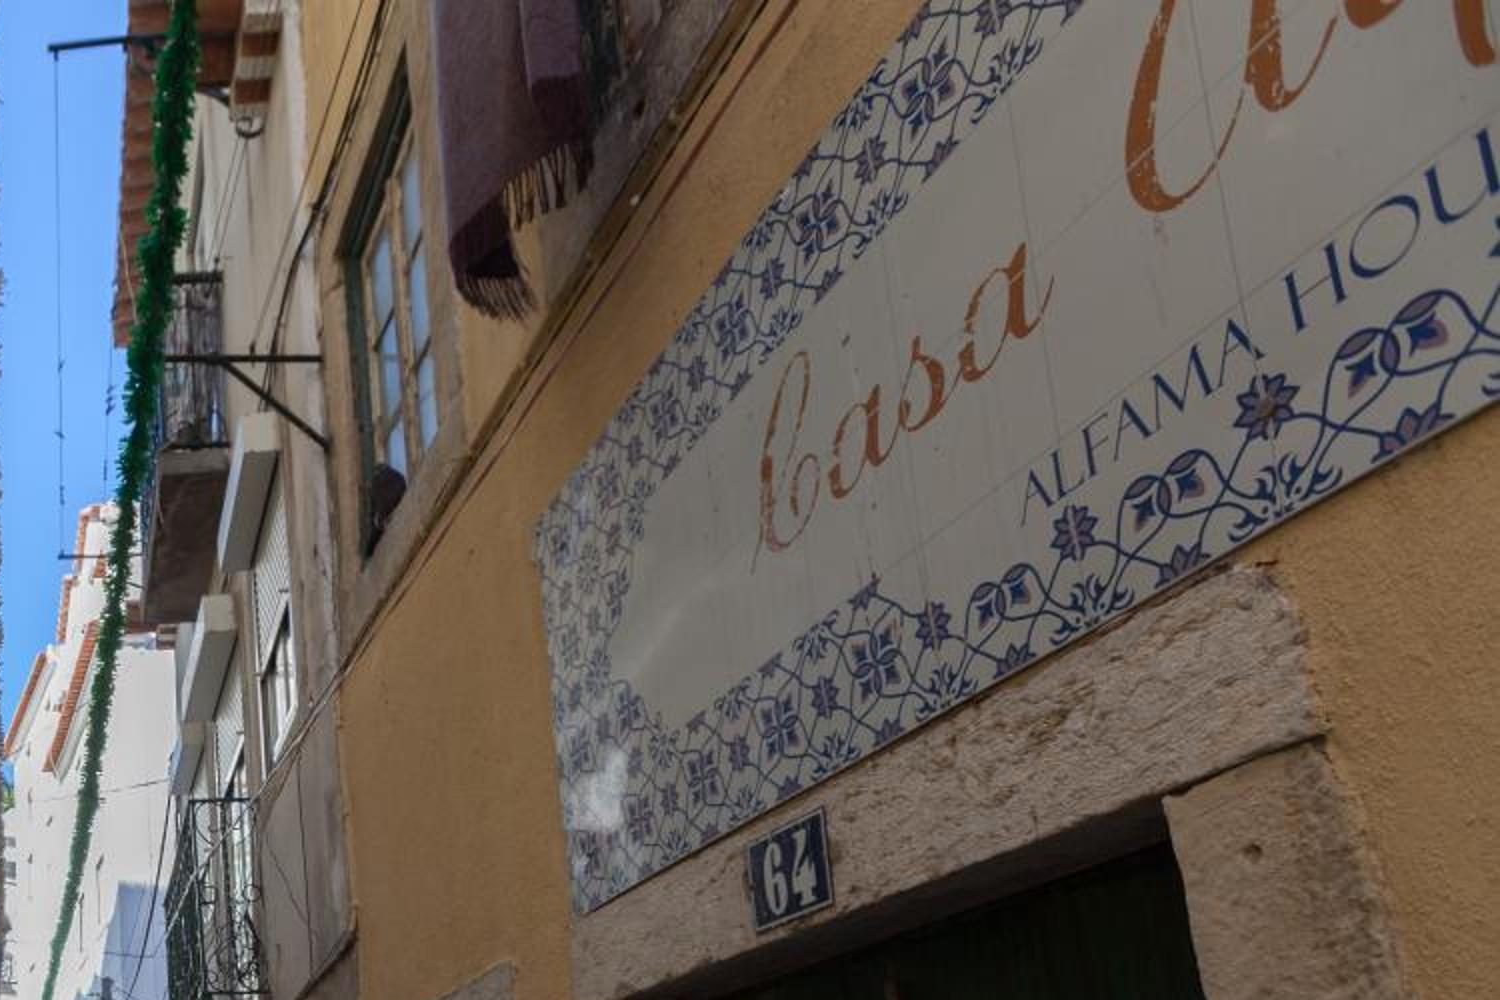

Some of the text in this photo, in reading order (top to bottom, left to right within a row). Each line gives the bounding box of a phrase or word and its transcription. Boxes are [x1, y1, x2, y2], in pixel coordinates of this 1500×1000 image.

[752, 241, 1055, 575] Casa
[1020, 318, 1265, 529] ALFAMA
[763, 828, 818, 916] 64
